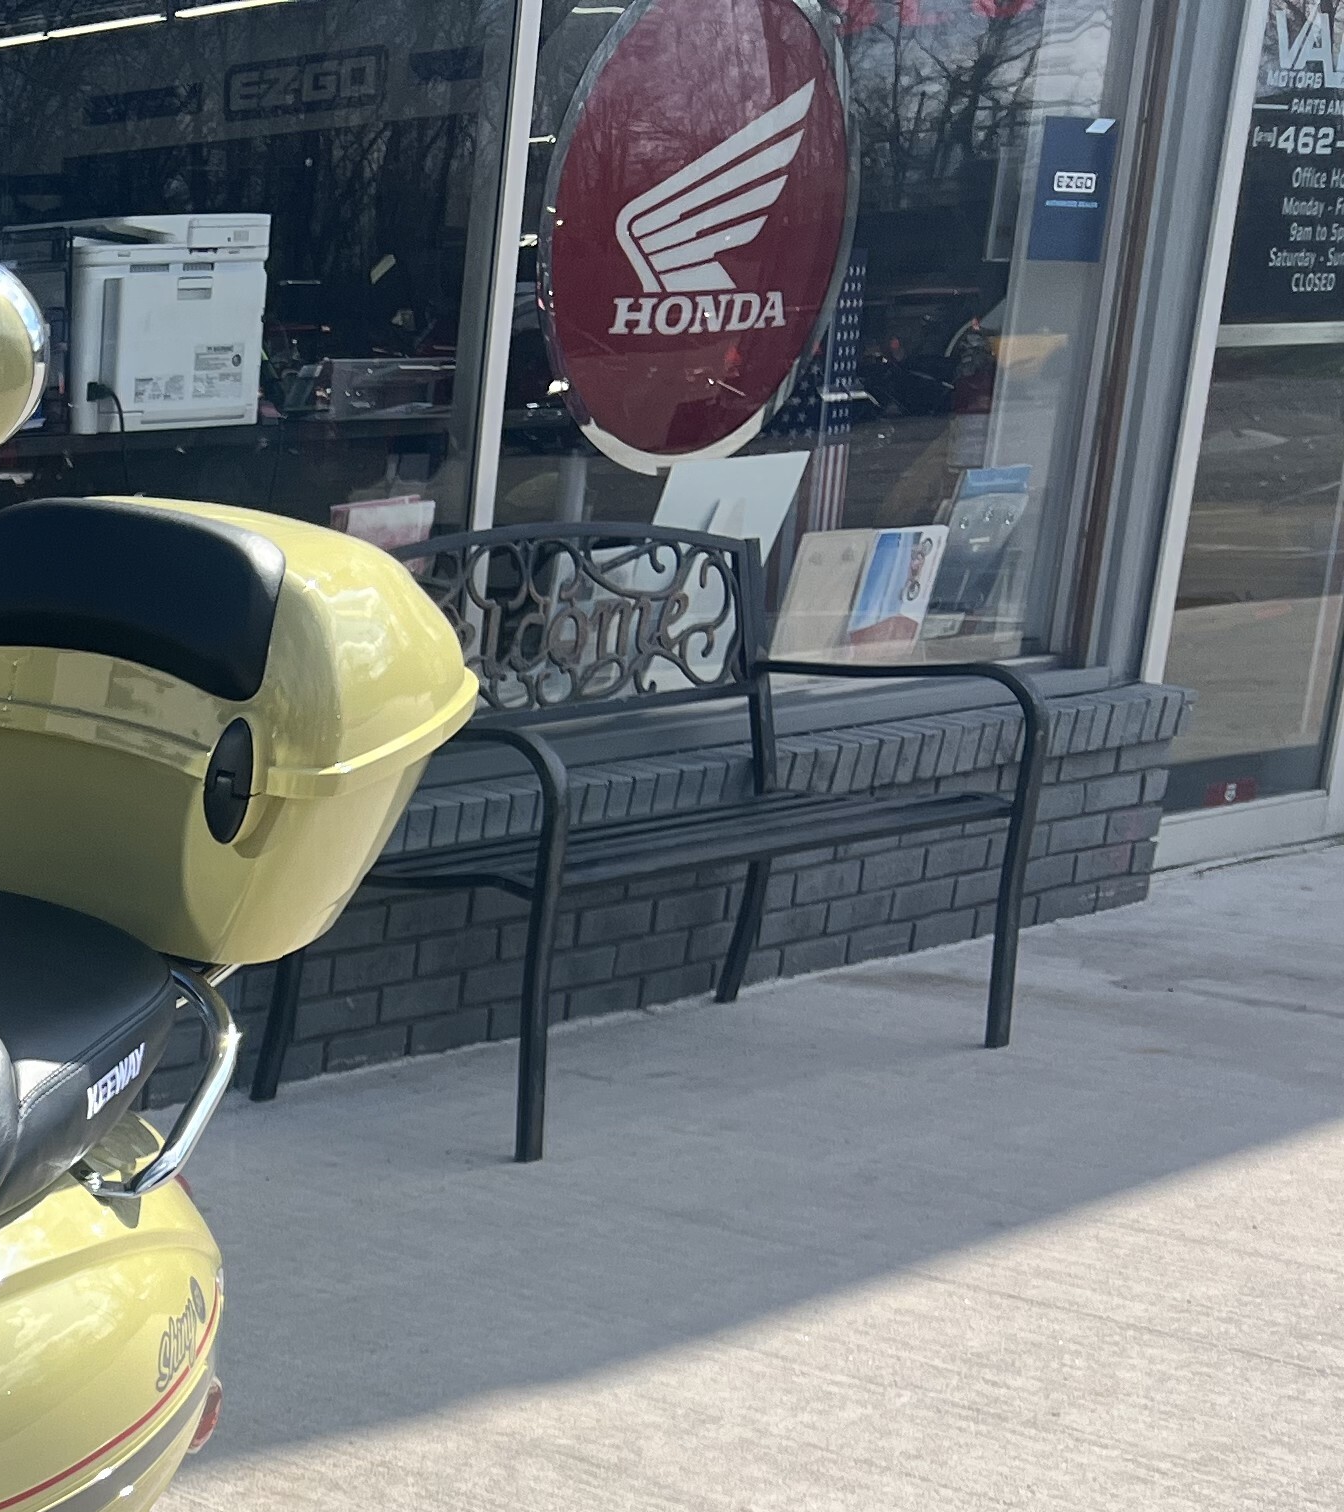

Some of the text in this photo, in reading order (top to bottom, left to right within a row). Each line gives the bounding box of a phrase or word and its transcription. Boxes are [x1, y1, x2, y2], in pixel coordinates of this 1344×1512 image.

[1275, 0, 1344, 88] VA
[1291, 98, 1326, 115] PARTS
[1056, 175, 1094, 190] EZGO
[1292, 167, 1327, 188] Office
[1281, 197, 1325, 218] Monday
[1289, 222, 1312, 242] 9am
[1315, 224, 1327, 241] to
[1268, 247, 1316, 269] Saturday
[1291, 272, 1336, 292] CLOSED
[608, 291, 787, 336] HONDA
[86, 1042, 146, 1120] KEEWAY
[156, 1297, 198, 1393] Shiny
